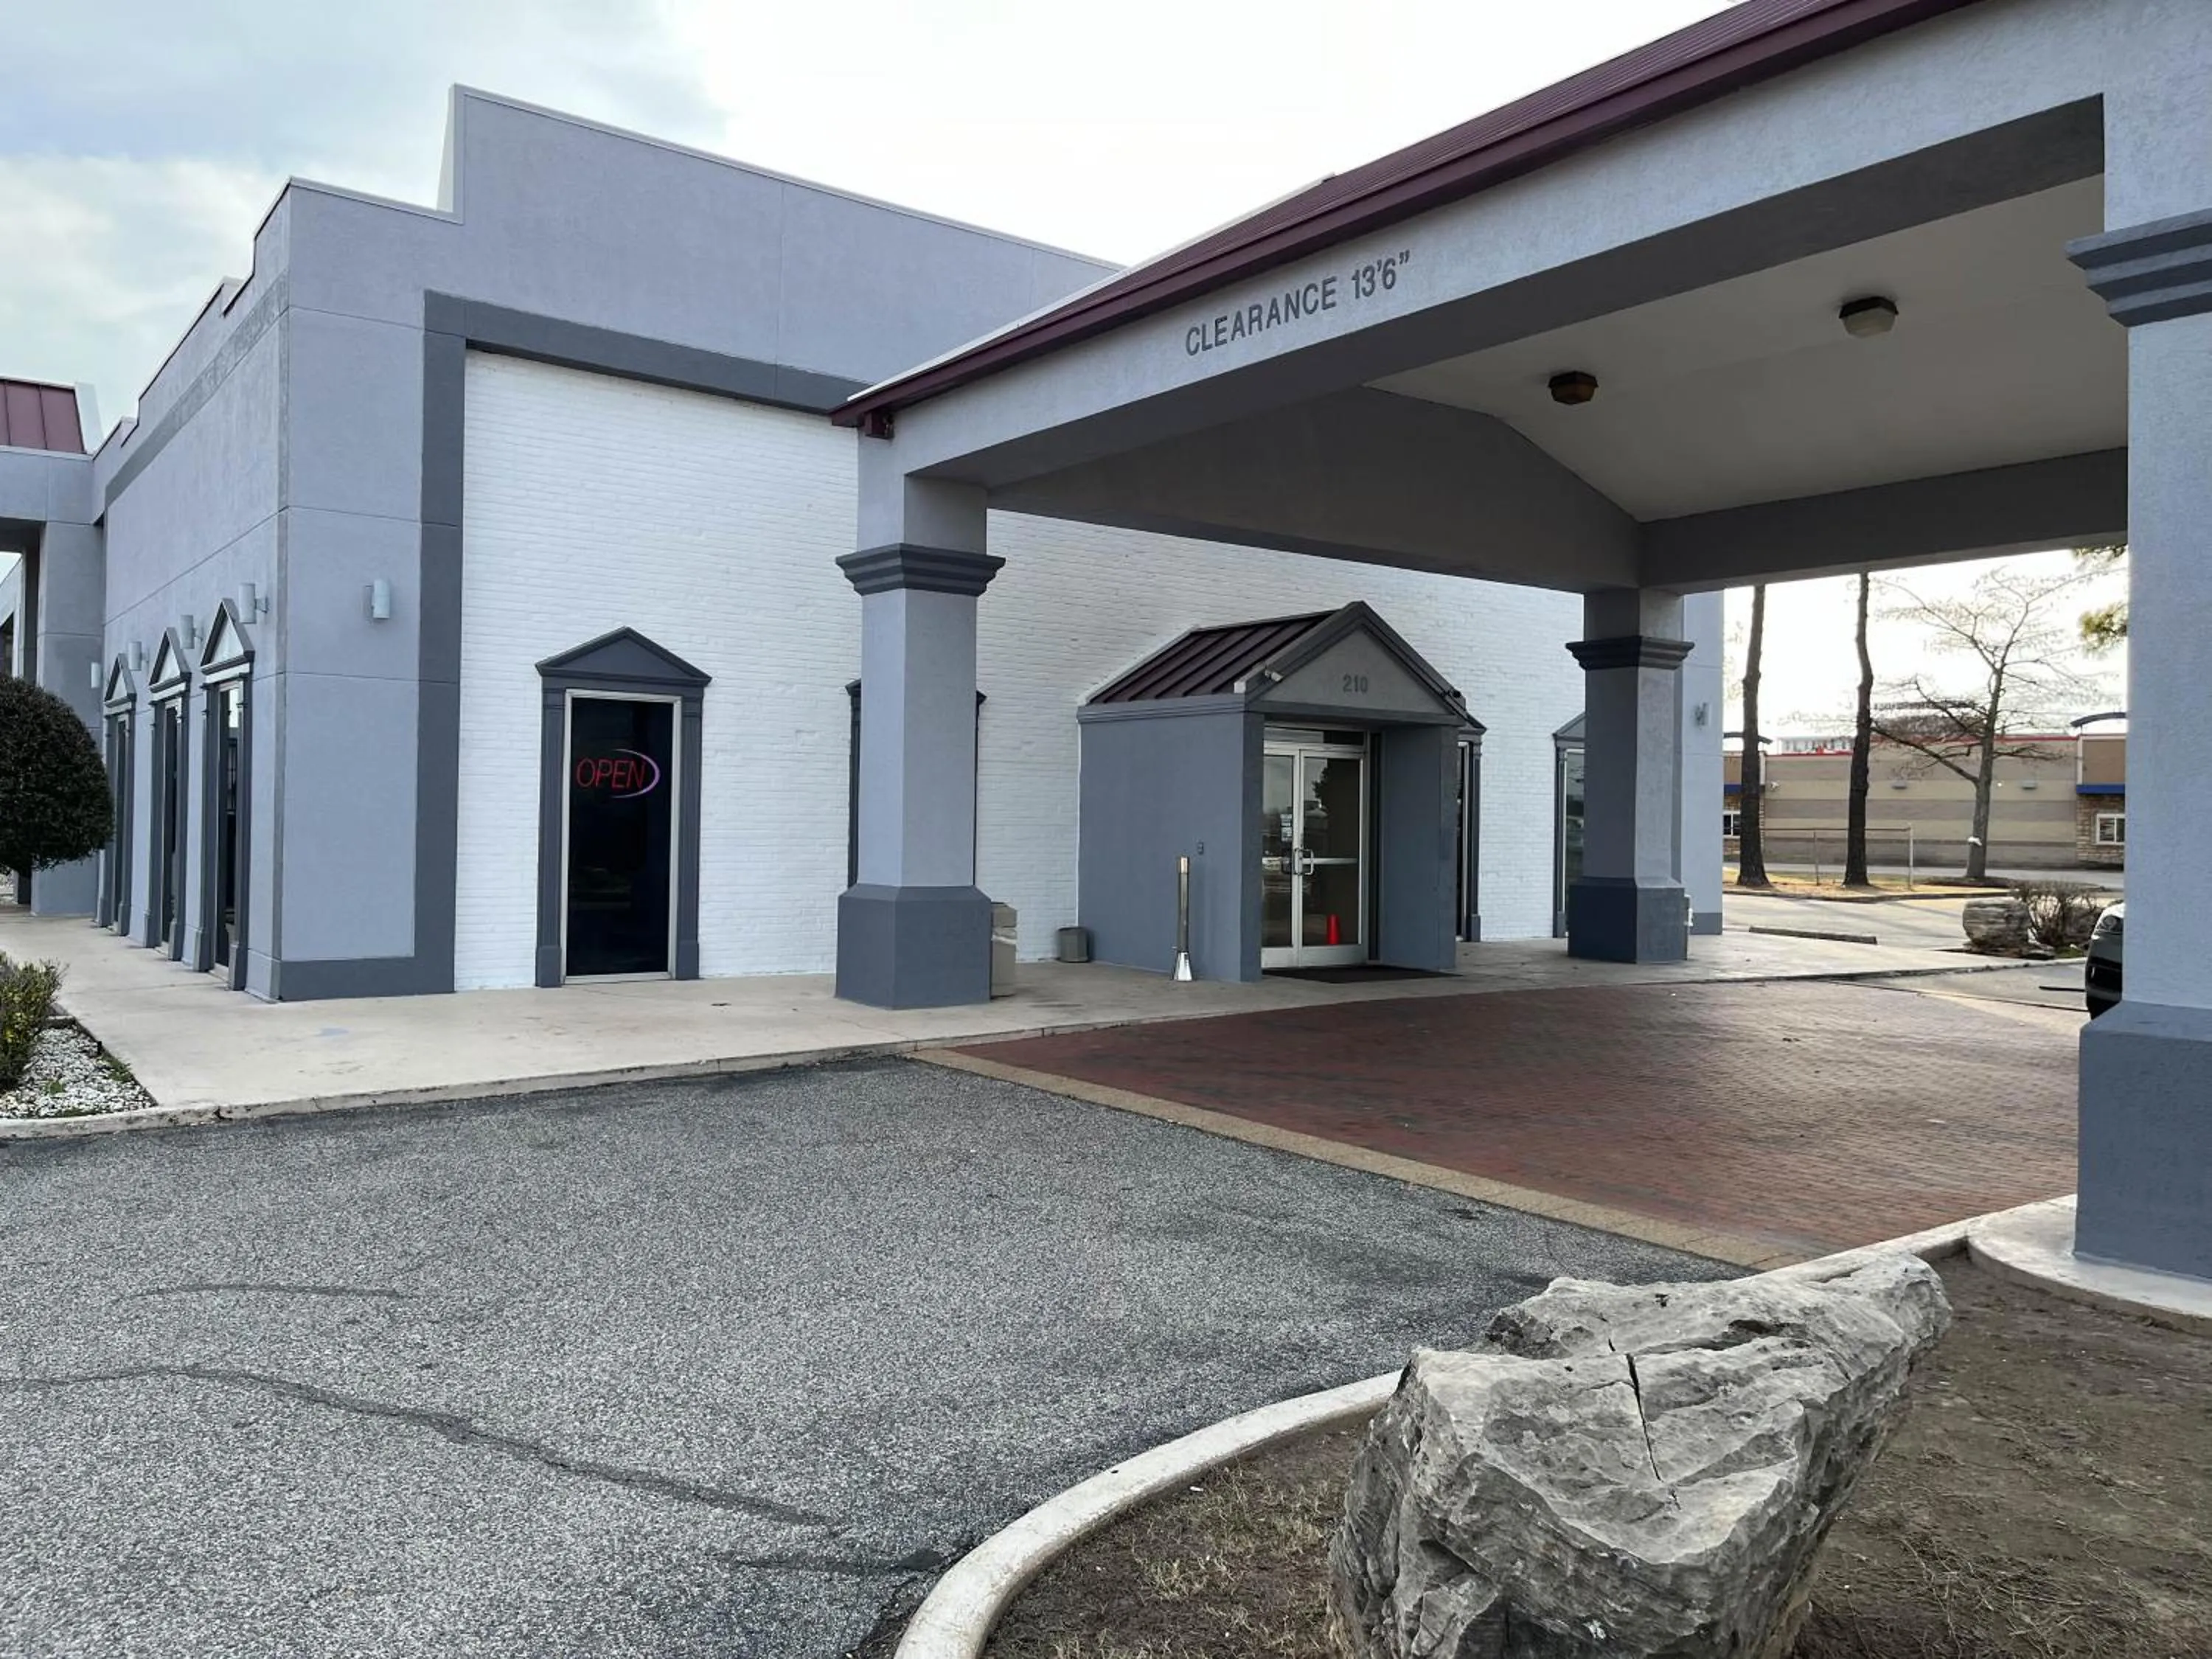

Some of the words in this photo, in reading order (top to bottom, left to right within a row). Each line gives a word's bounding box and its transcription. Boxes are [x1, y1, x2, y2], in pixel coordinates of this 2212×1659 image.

[1185, 276, 1338, 356] CLEARANCE
[1343, 674, 1368, 693] 210
[577, 757, 646, 788] OPEN
